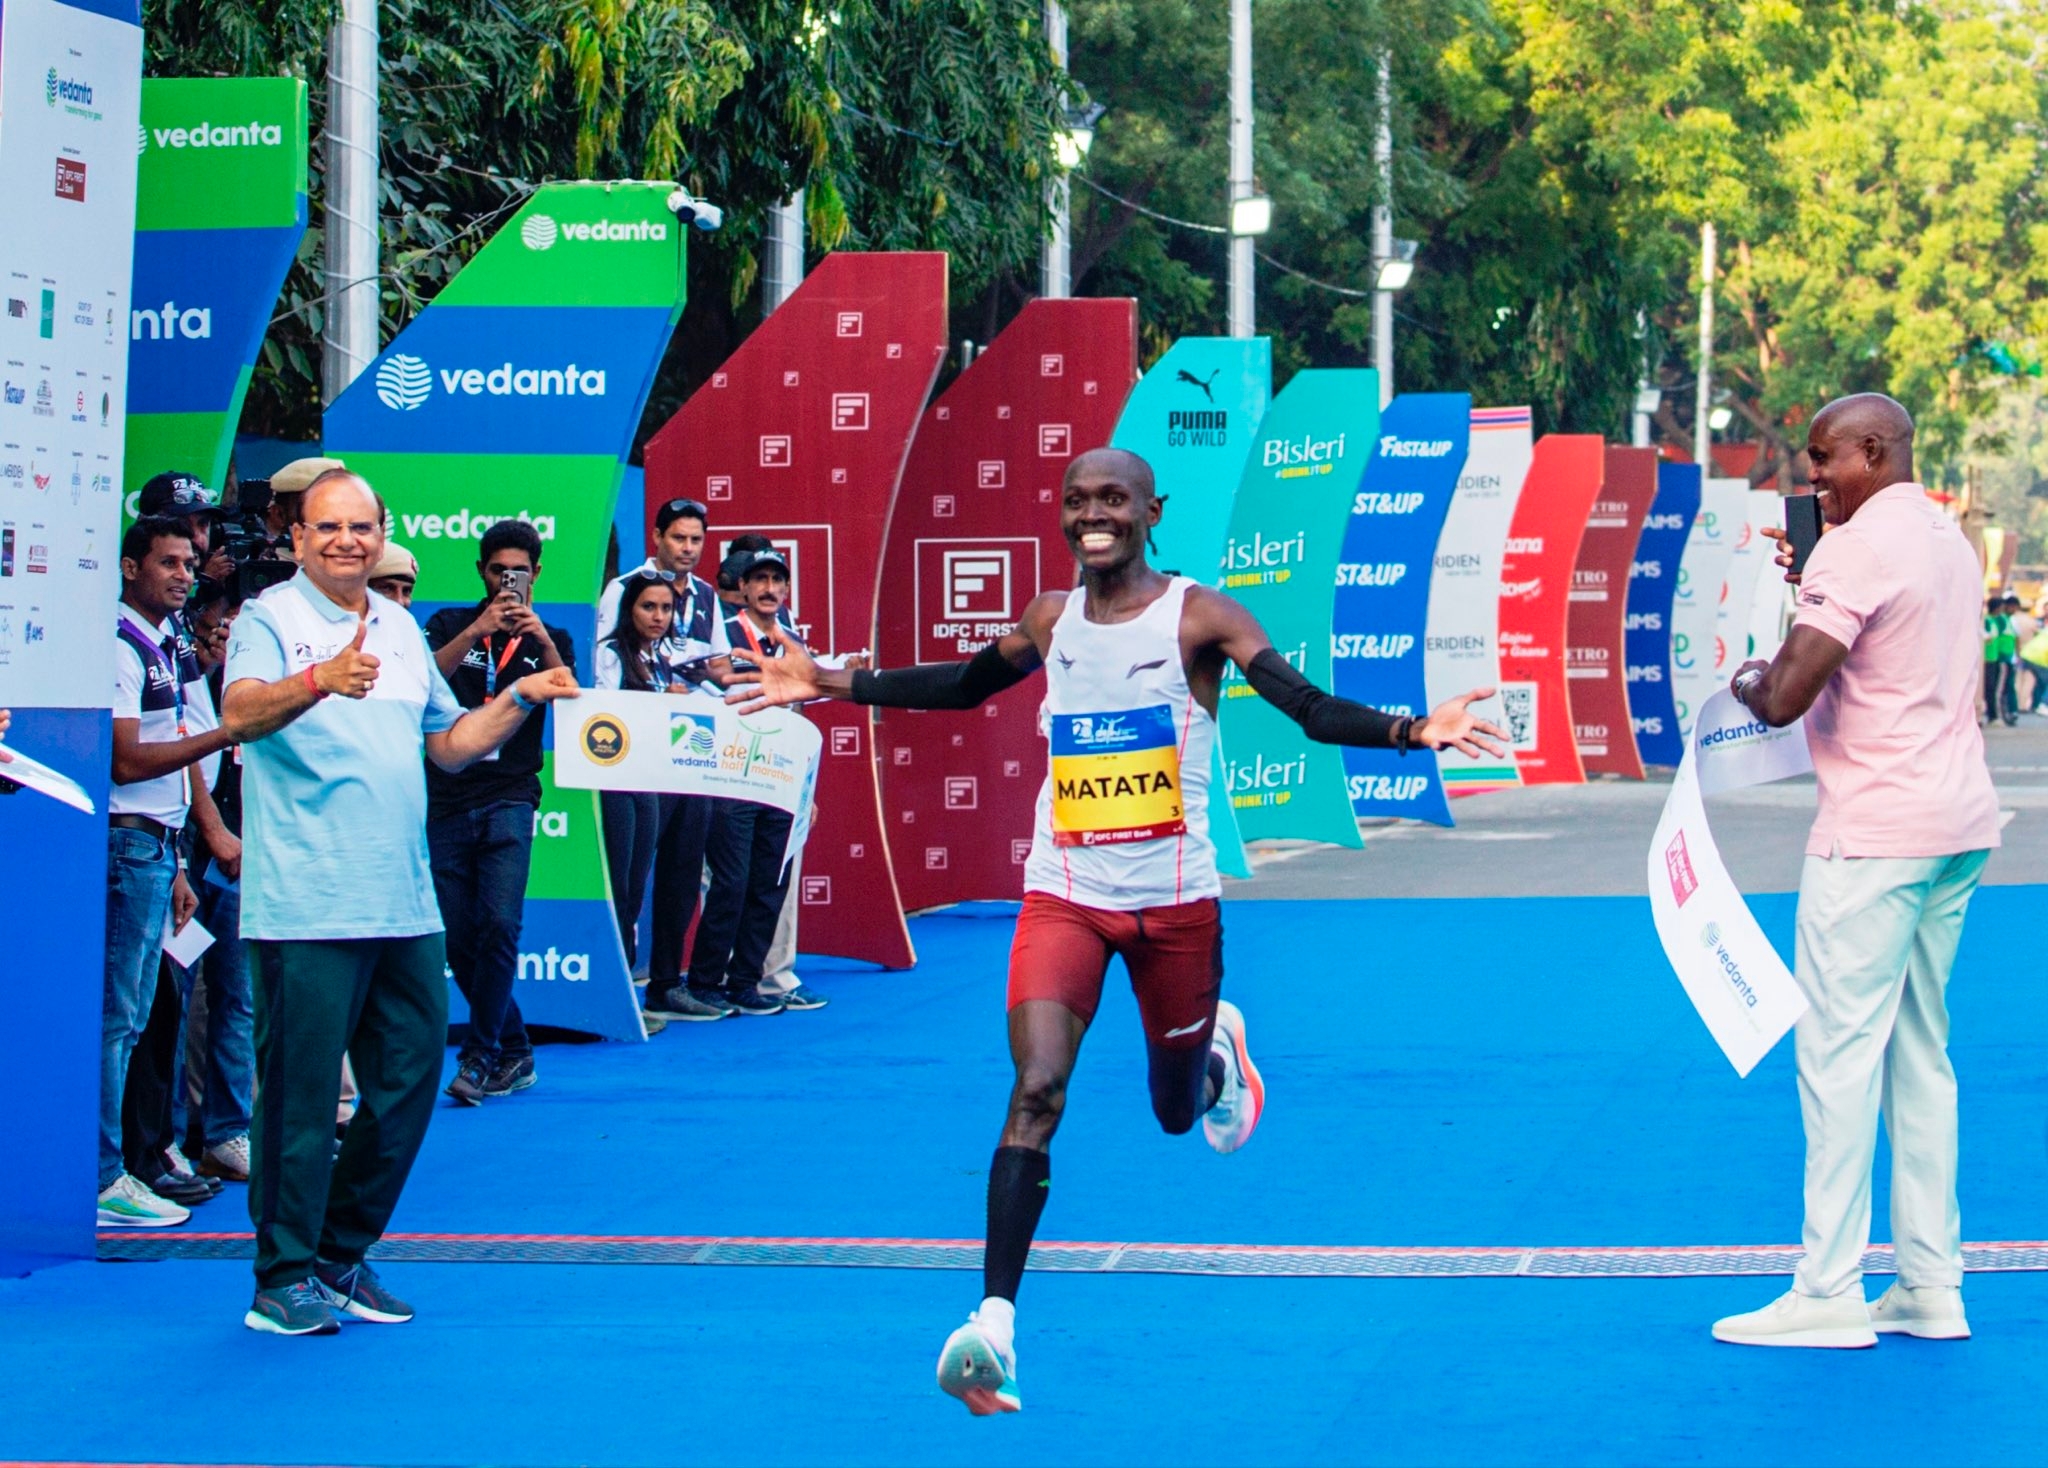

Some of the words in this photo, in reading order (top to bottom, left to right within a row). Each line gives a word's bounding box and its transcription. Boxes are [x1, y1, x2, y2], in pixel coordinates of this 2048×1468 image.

[58, 77, 92, 105] vedanta
[153, 122, 282, 149] vedanta
[561, 219, 667, 242] vedanta
[440, 362, 606, 396] vedanta
[1169, 411, 1227, 430] PUMA
[1168, 431, 1186, 447] GO
[1190, 431, 1226, 446] WILD
[1263, 432, 1346, 467] Bisleri
[1380, 435, 1453, 457] FAST&UP
[1457, 474, 1500, 490] IDIEN
[1351, 492, 1424, 514] ST&UP
[401, 508, 555, 540] vedaa
[1222, 531, 1305, 569] isleri
[1335, 563, 1406, 586] ST&UP
[1571, 570, 1608, 583] TRO
[933, 623, 971, 638] IDFC
[1426, 635, 1484, 651] ERIDIEN
[1574, 725, 1608, 738] TRO
[672, 757, 717, 768] vedanta
[723, 731, 771, 777] delhi
[721, 759, 744, 770] half
[751, 764, 794, 784] marathon
[1223, 753, 1306, 791] isleri
[1057, 770, 1173, 800] MATATA
[1170, 805, 1180, 817] 3
[1716, 944, 1758, 1008] vedanta
